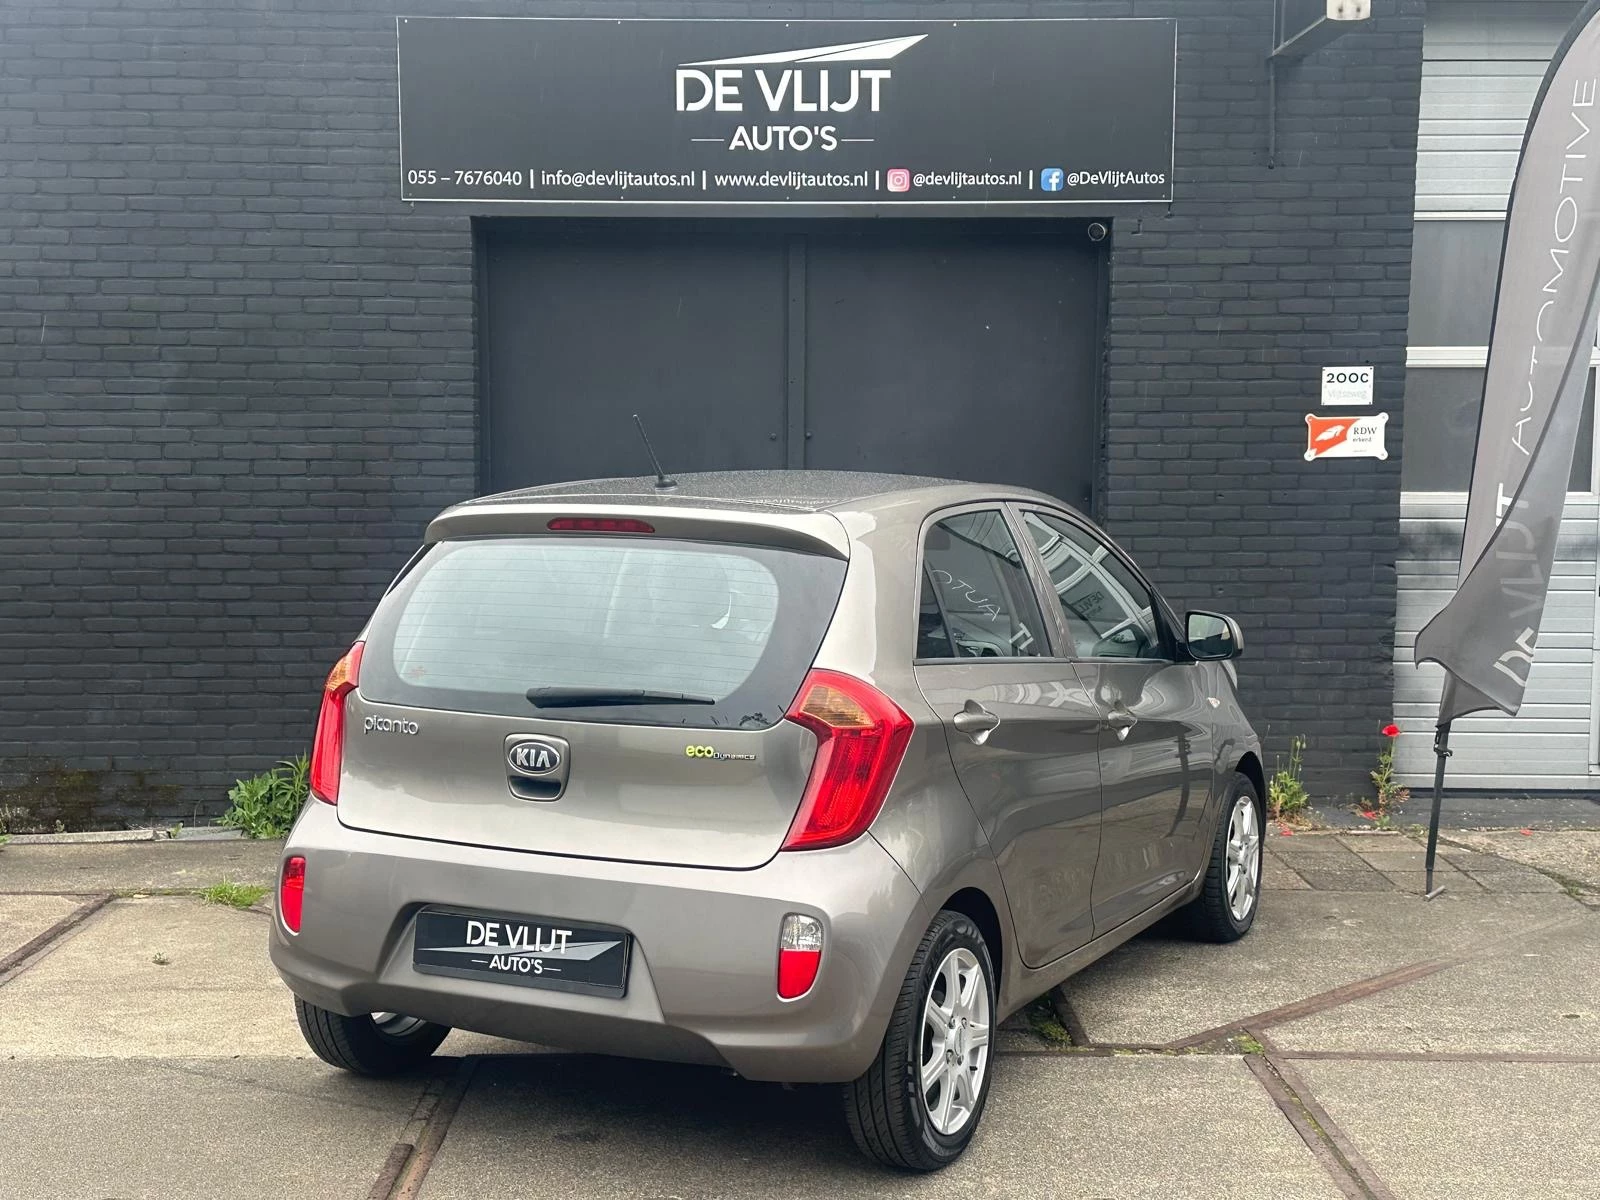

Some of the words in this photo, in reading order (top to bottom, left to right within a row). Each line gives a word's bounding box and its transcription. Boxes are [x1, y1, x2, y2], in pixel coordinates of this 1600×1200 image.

[675, 69, 743, 112] DE
[754, 69, 892, 113] VLIJT
[728, 125, 838, 151] AUTO'S
[407, 169, 437, 186] 055
[454, 169, 523, 187] 7676040
[541, 169, 695, 190] info@devlijtautos.nl
[714, 170, 868, 190] www.devlijtautos.nl
[912, 170, 1022, 189] @devlijtautos.nl
[1066, 170, 1165, 188] @DeVlijtAutos
[1353, 426, 1377, 435] RDW
[363, 715, 419, 735] picanto
[516, 748, 551, 768] KIA
[466, 920, 500, 948] DE
[505, 924, 573, 955] VLIJT
[489, 954, 544, 974] AUTO'S
